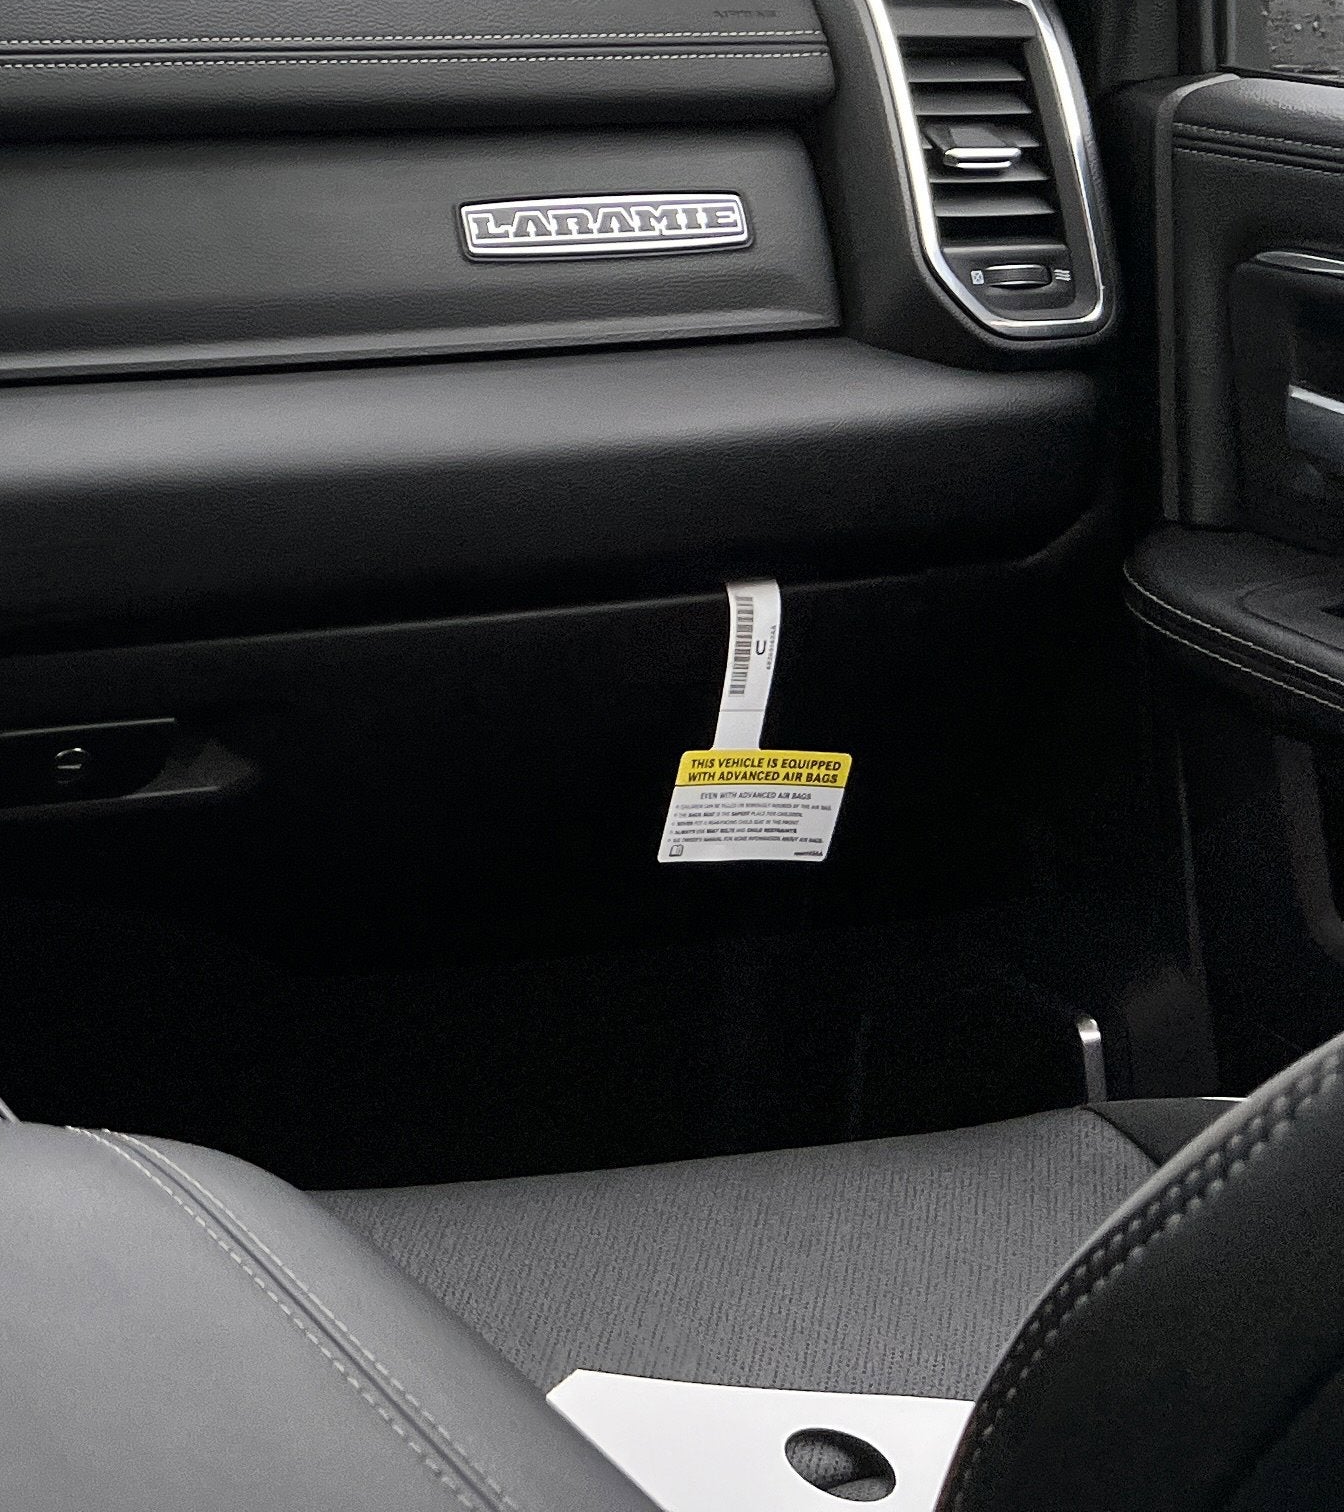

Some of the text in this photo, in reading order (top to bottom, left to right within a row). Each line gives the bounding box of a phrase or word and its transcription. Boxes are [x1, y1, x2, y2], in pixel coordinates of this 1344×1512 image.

[468, 202, 740, 244] LARAMIE
[691, 757, 842, 771] THIS VEHICLE IS EQUIPPED
[688, 770, 838, 784] WITH ADVANCED AIR BAGS
[738, 791, 776, 799] ADVANCED
